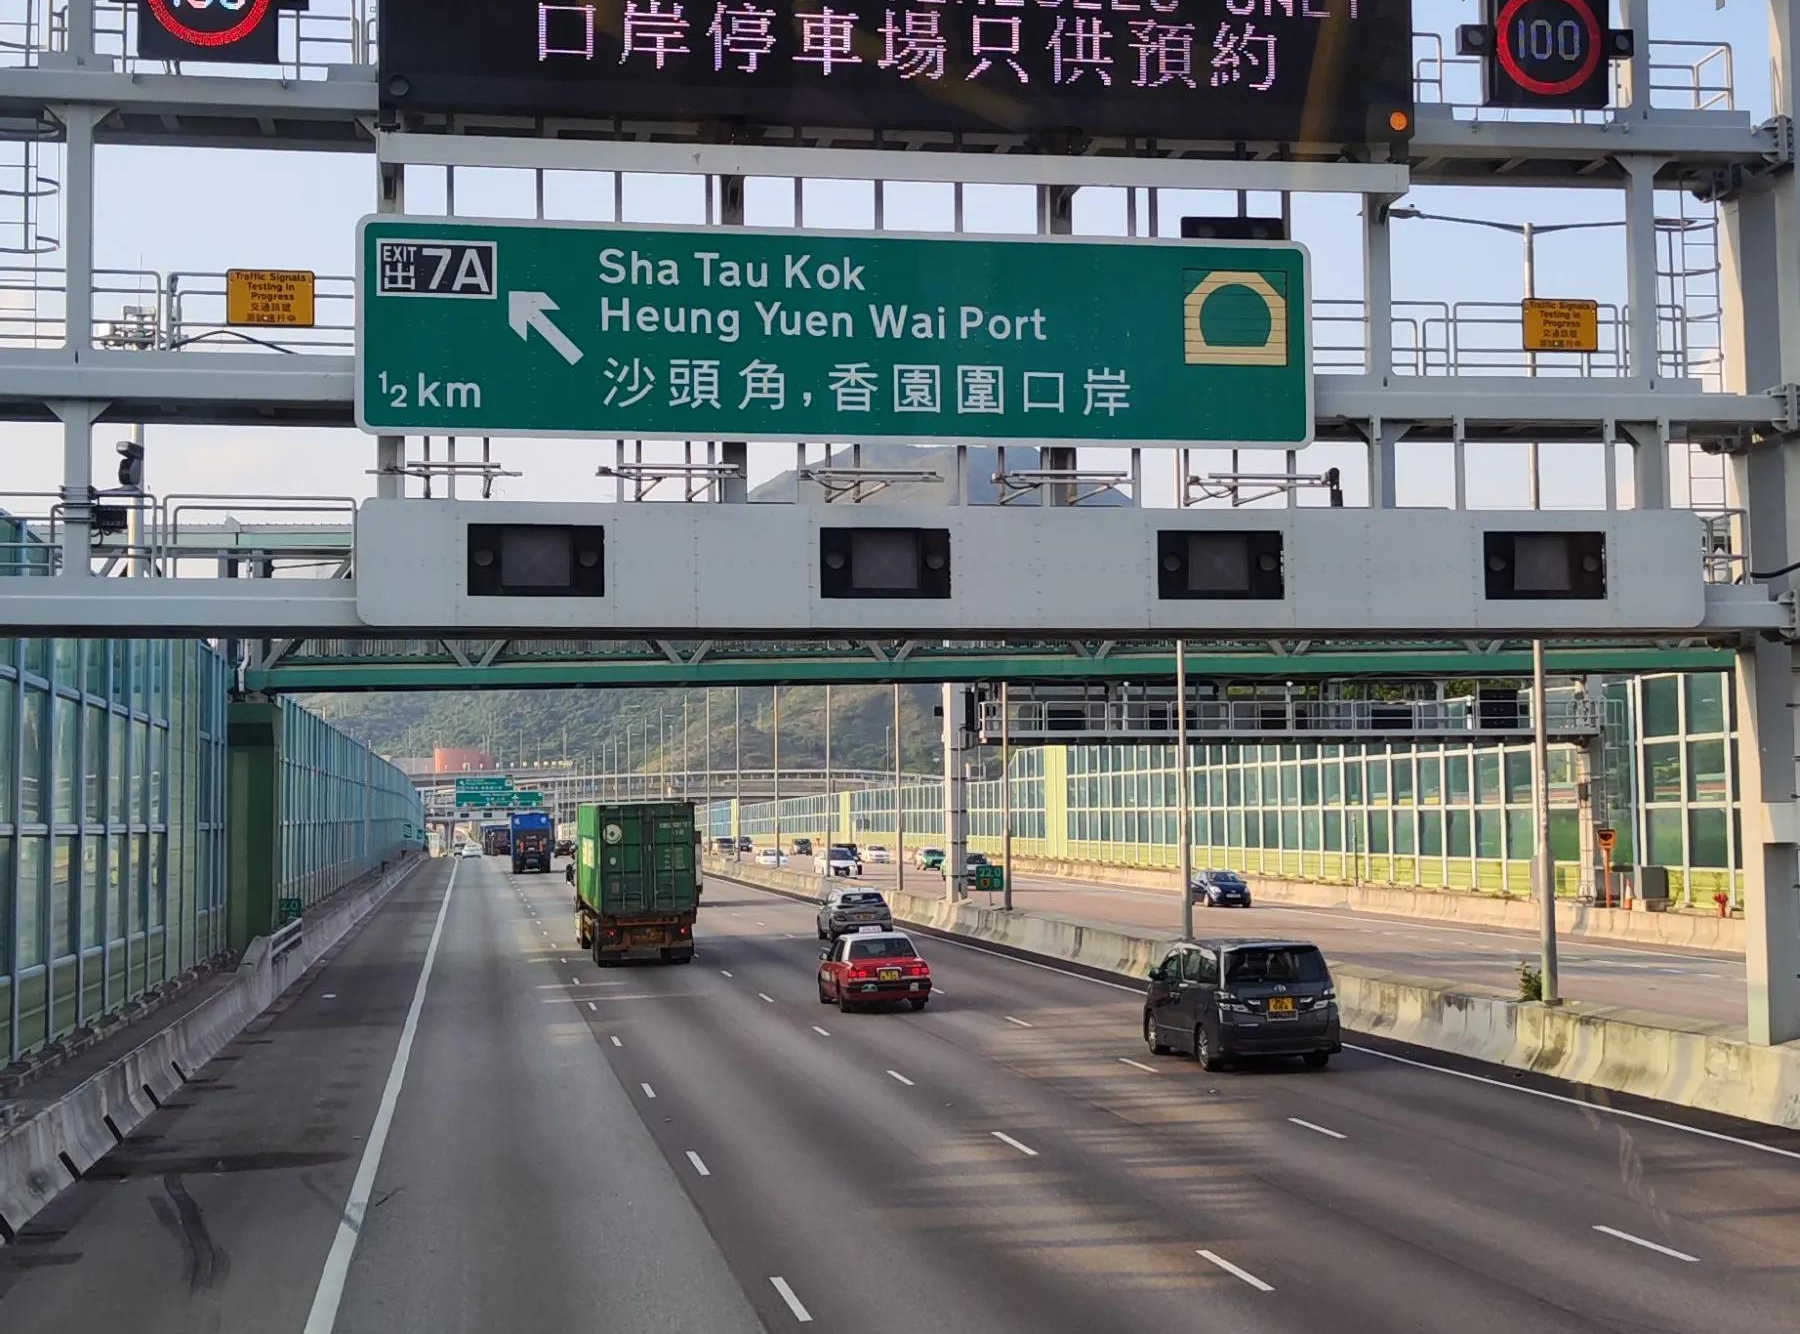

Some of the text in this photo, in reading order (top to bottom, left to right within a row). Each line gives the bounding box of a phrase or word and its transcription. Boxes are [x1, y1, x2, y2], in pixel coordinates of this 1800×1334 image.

[1518, 18, 1580, 61] 100
[383, 245, 417, 262] EXIT
[421, 247, 490, 292] 7A
[235, 272, 306, 283] Traffic Signals
[384, 262, 416, 290] 出
[599, 249, 866, 291] Sha Tau Kok
[247, 282, 283, 292] Testing
[251, 292, 295, 303] Progress
[601, 296, 1047, 343] Heung Yuen Wai Port
[418, 372, 481, 408] km
